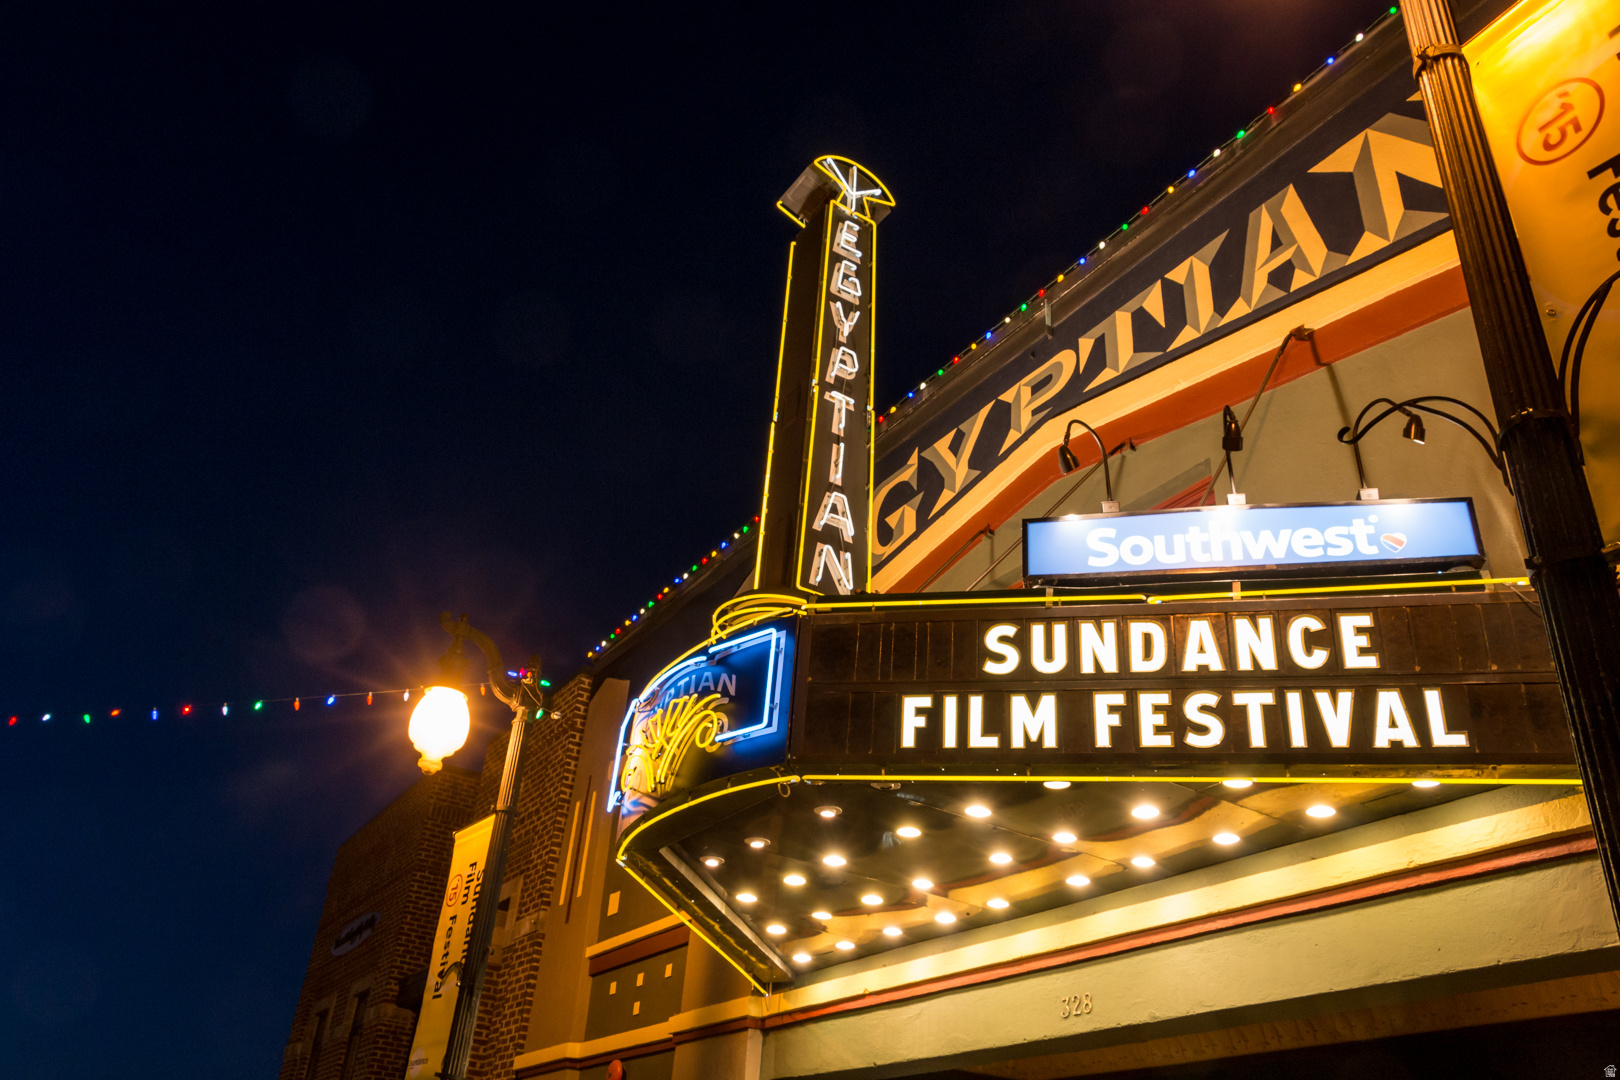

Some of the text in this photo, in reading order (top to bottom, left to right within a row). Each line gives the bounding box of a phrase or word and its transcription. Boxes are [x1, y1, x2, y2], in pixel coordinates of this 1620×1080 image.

[868, 90, 1451, 567] GYPTIAN
[811, 219, 861, 595] EGYPTIAN
[1086, 515, 1380, 568] Southwest
[982, 612, 1381, 675] SUNDANCE
[654, 671, 737, 711] PTIAN
[900, 687, 1471, 750] FILM FESTIVAL
[461, 861, 477, 905] Film
[432, 914, 457, 1000] Festival
[1060, 992, 1092, 1019] 328
